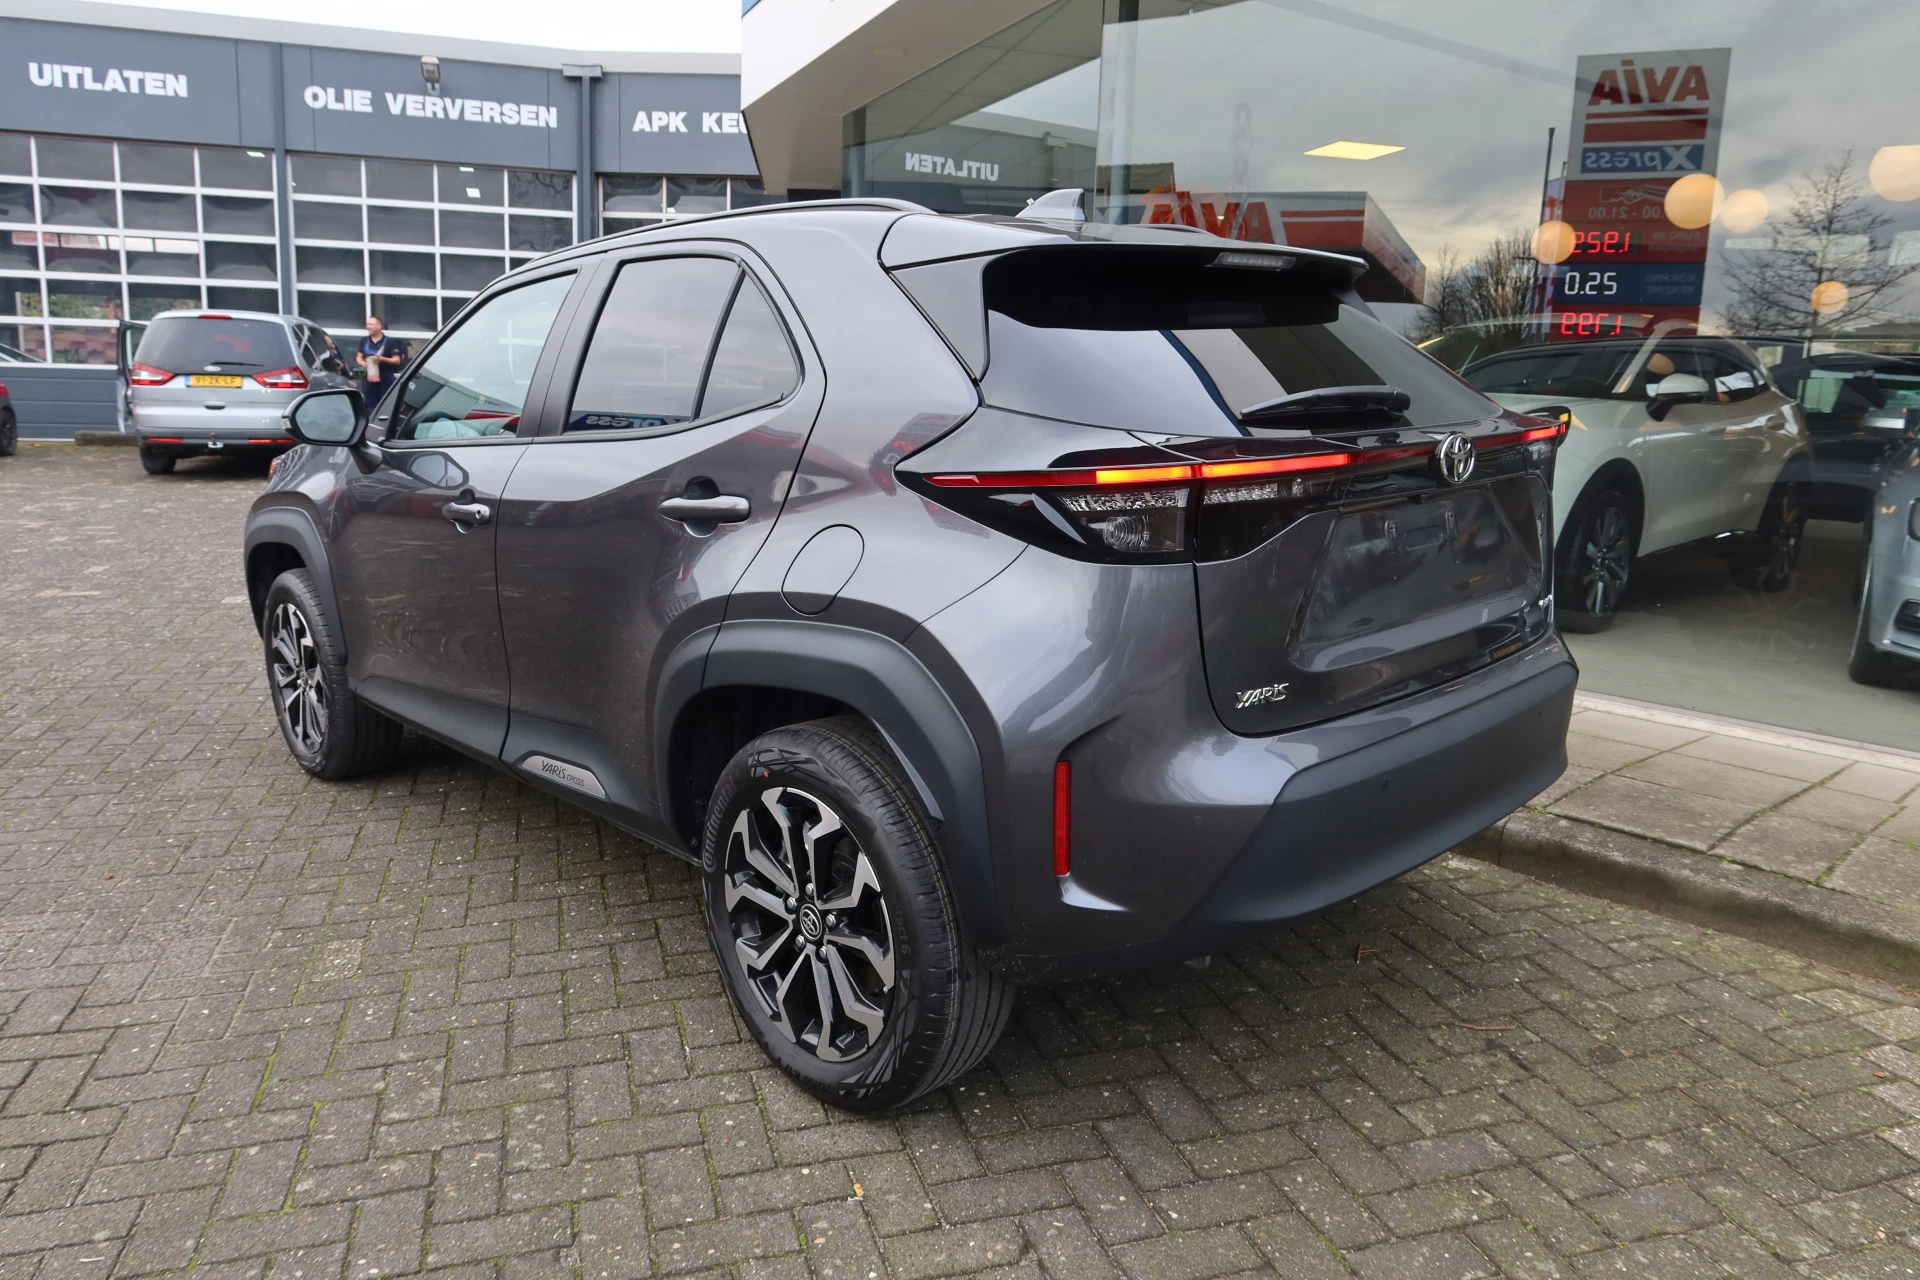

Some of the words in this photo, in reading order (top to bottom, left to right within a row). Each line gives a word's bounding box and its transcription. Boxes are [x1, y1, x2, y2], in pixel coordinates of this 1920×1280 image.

[28, 62, 188, 97] UITLATEN
[304, 85, 373, 113] OLIE
[385, 92, 558, 128] VERVERSEN
[632, 110, 688, 133] APK
[1235, 683, 1289, 709] YARIS
[542, 760, 568, 779] YARIS
